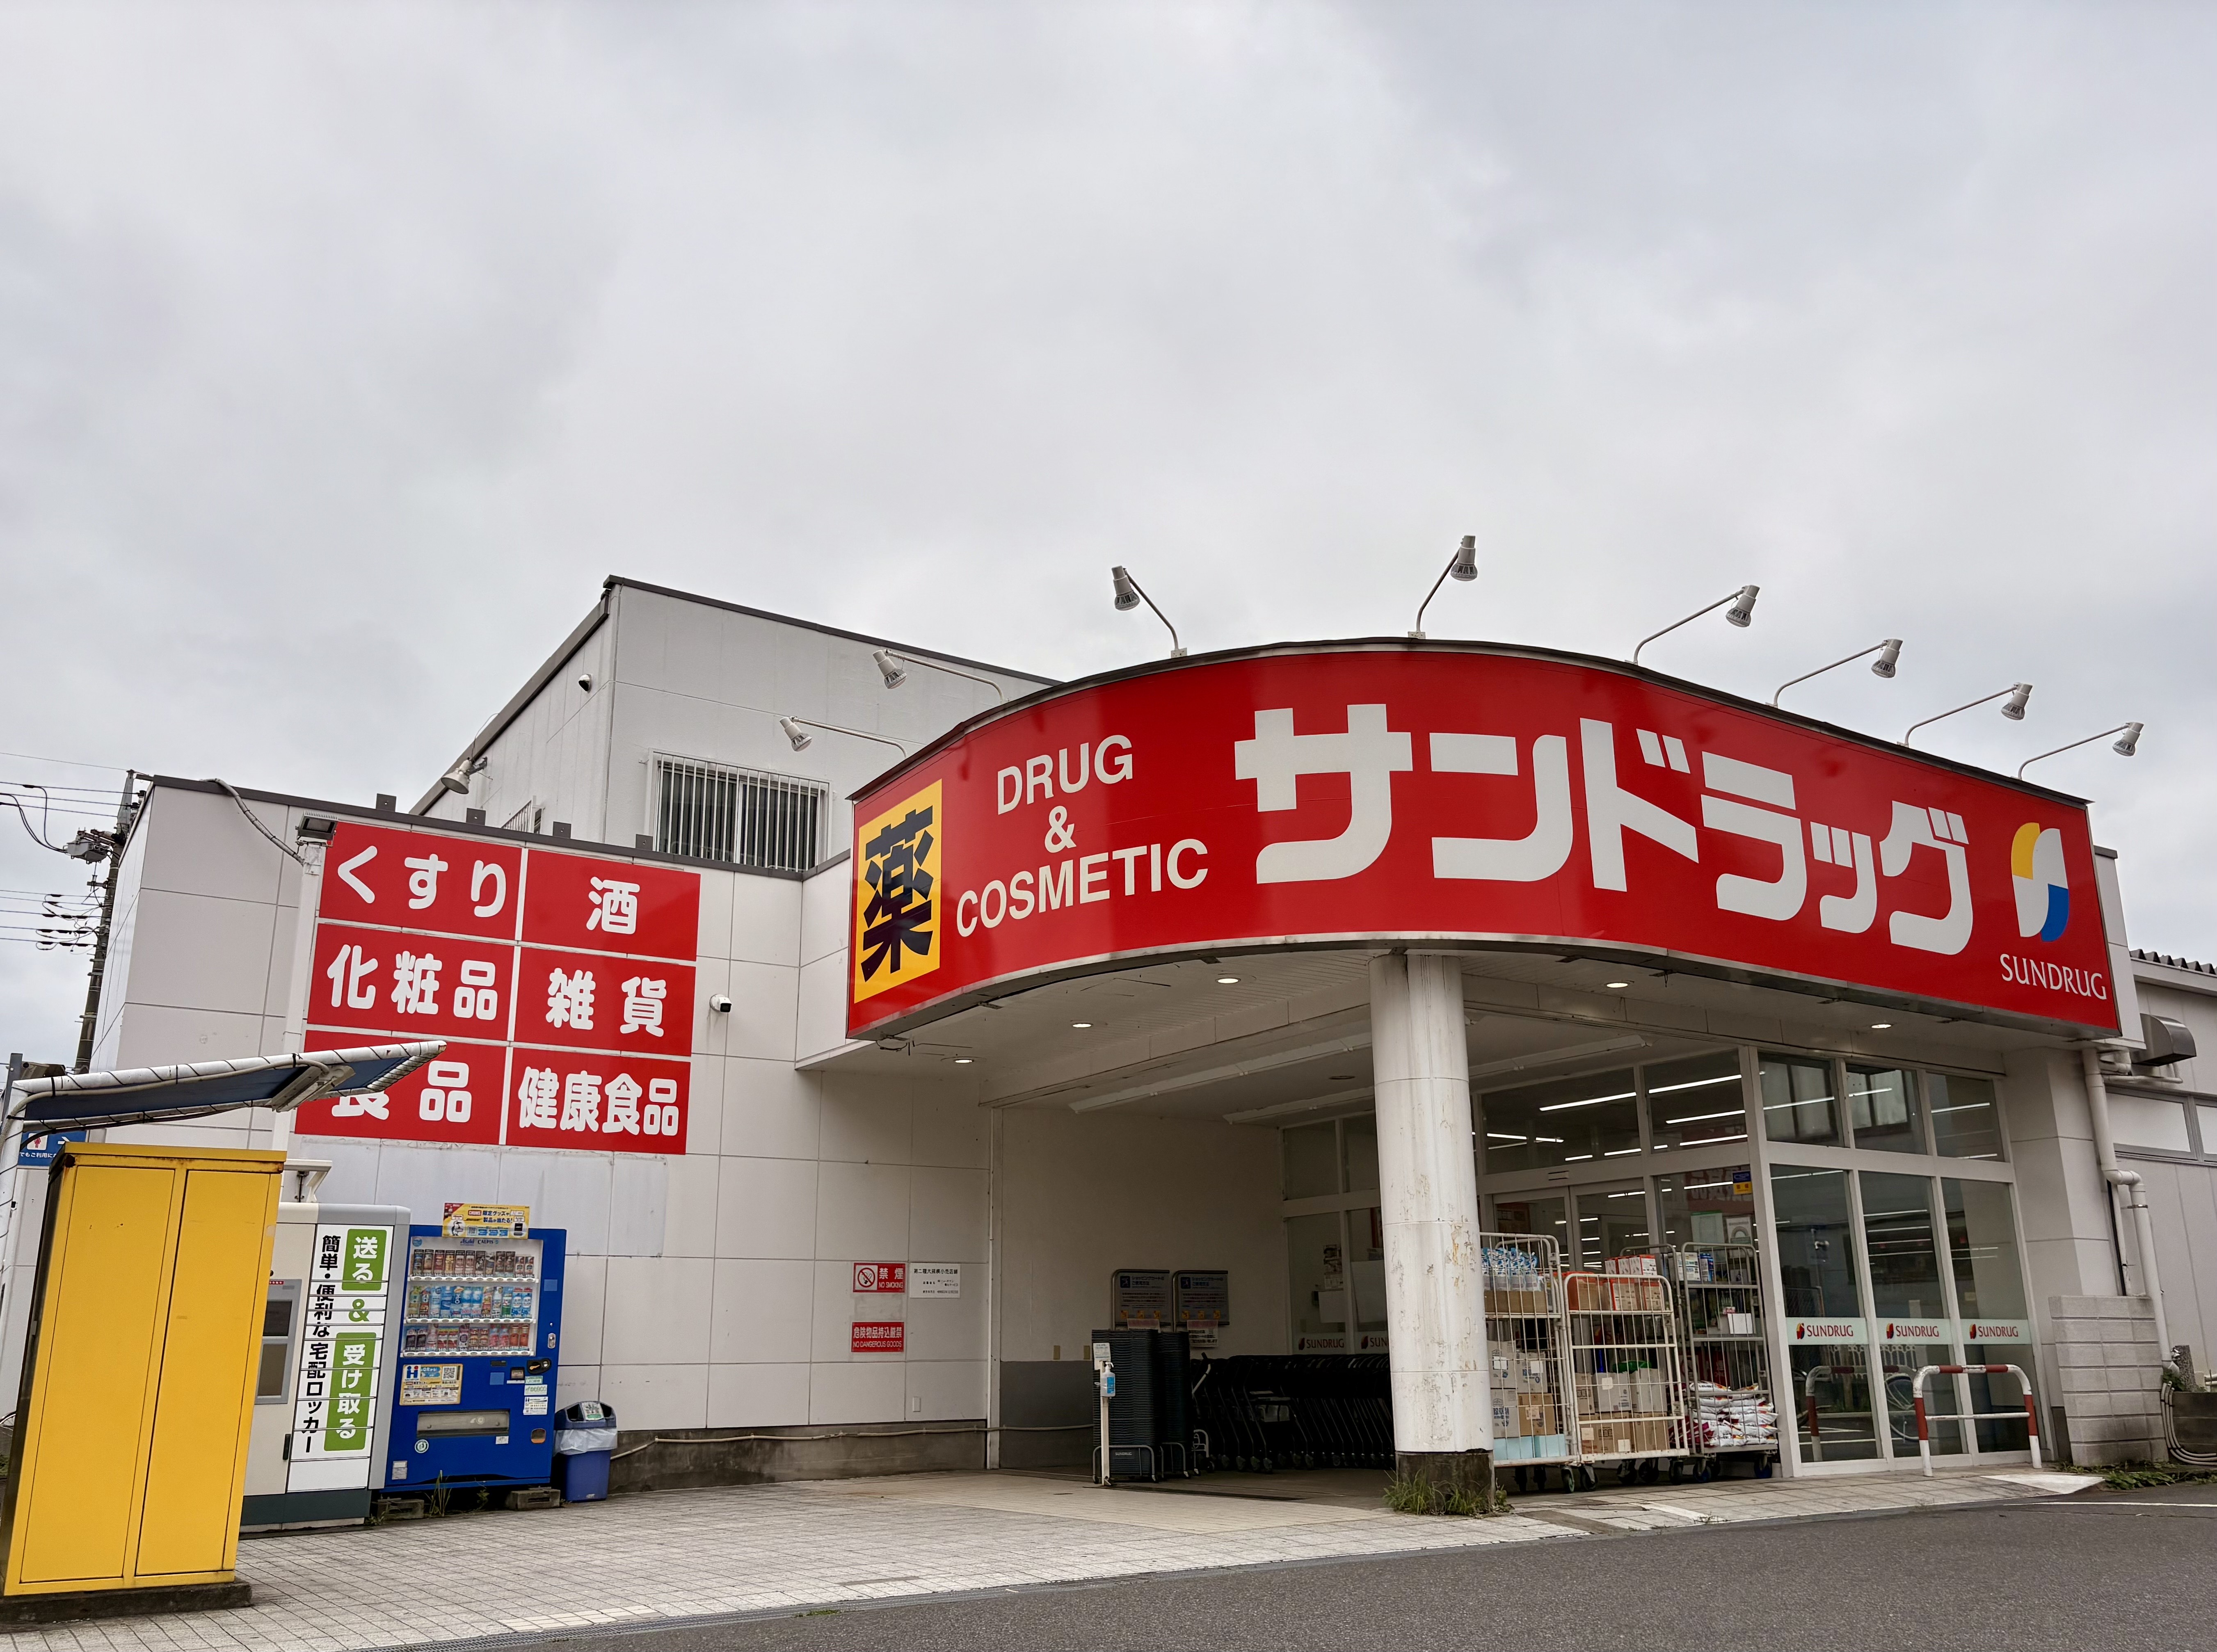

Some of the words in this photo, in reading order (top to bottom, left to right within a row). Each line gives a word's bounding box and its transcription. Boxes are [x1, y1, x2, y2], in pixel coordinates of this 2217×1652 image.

[998, 735, 1132, 815] DRUG
[1045, 806, 1077, 853] &
[1234, 704, 1973, 955] サンドラッグ
[338, 846, 506, 918] くすり
[586, 877, 640, 935] 酒
[861, 805, 933, 982] 薬
[957, 839, 1208, 937] COSMETIC
[327, 944, 498, 1020] 化粧品
[546, 968, 666, 1037] 雑貨
[2000, 954, 2106, 999] SUNDRUG
[518, 1067, 679, 1136] 健康食品
[352, 1236, 377, 1284] 送る
[880, 1268, 903, 1280] 禁煙
[349, 1299, 369, 1322] &
[1807, 1325, 1853, 1337] SUNDRUG
[1896, 1325, 1939, 1337] SUNDRUG
[1979, 1326, 2018, 1337] SUNDRUG
[302, 1235, 341, 1453] 簡単・便利な宅配ロッカー
[1306, 1338, 1344, 1349] SUNDRUG
[336, 1344, 366, 1438] 受け取る
